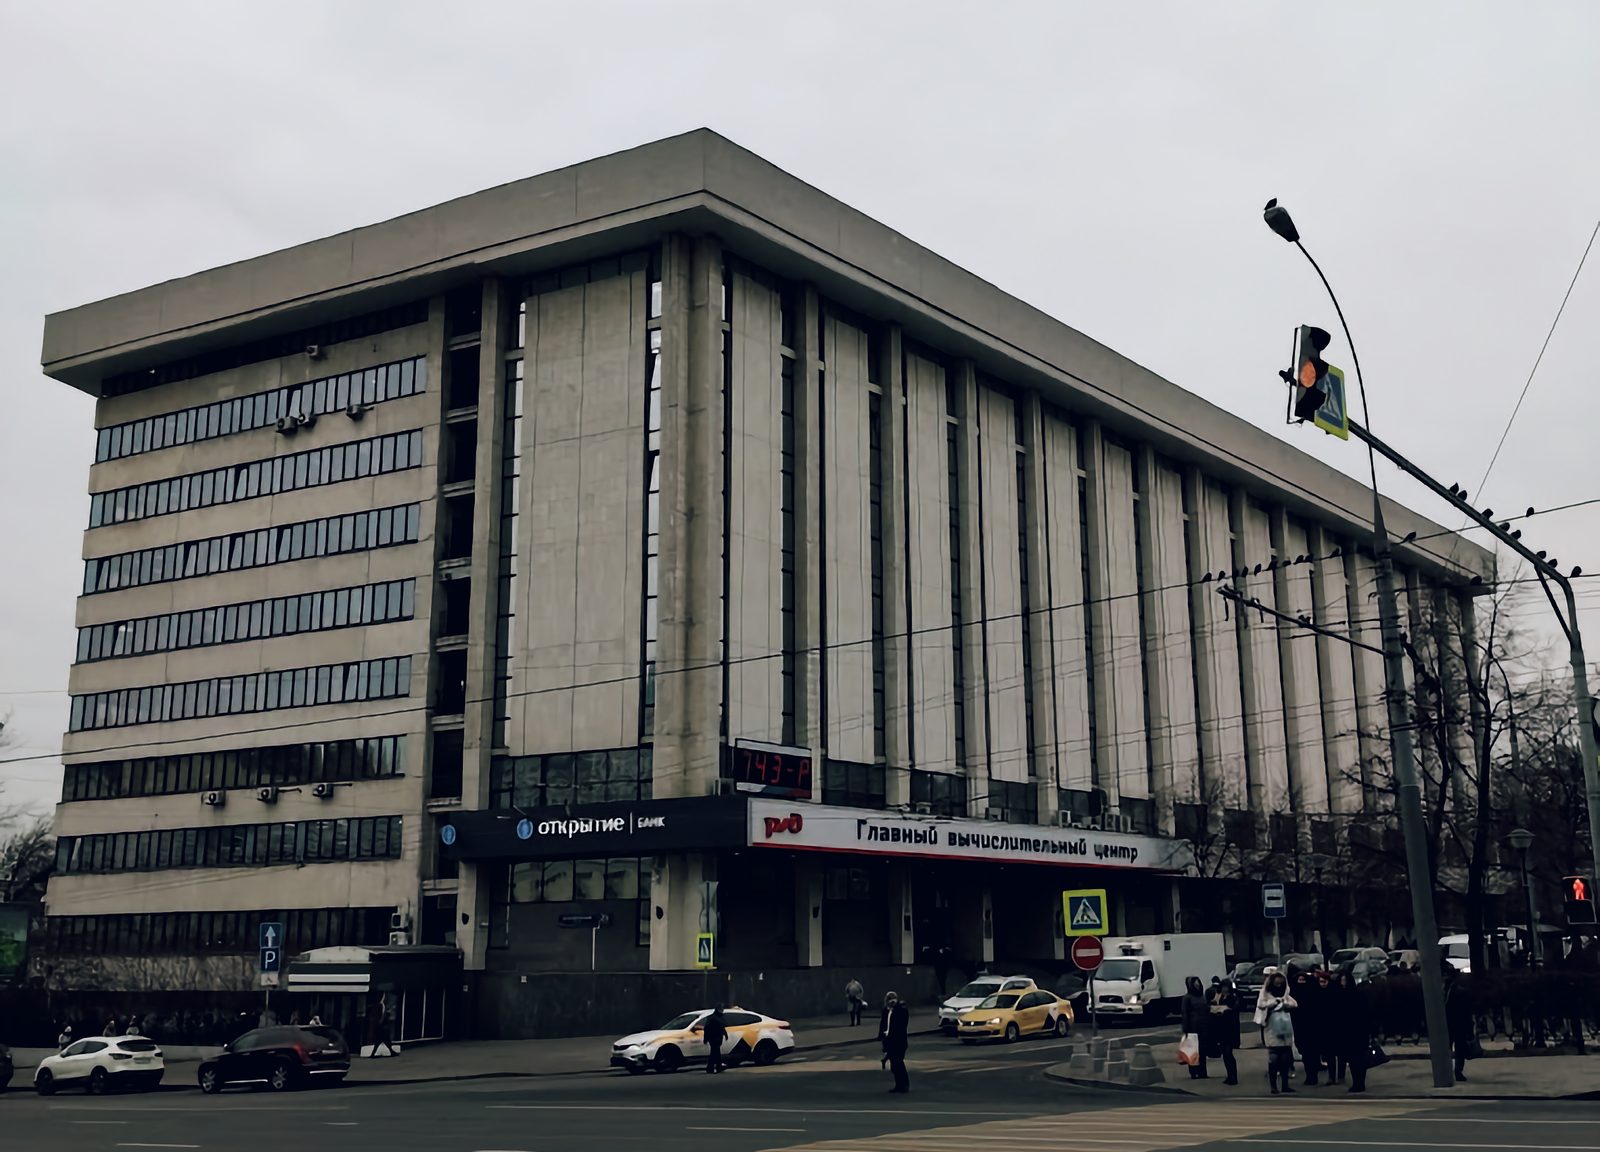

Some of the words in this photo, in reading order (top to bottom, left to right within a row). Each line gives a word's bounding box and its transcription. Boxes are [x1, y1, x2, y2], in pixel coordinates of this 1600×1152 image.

[538, 817, 625, 839] открытие
[857, 819, 938, 845] Главный
[948, 831, 1087, 856] вычислительный
[1094, 843, 1138, 863] центр
[265, 950, 276, 969] P
